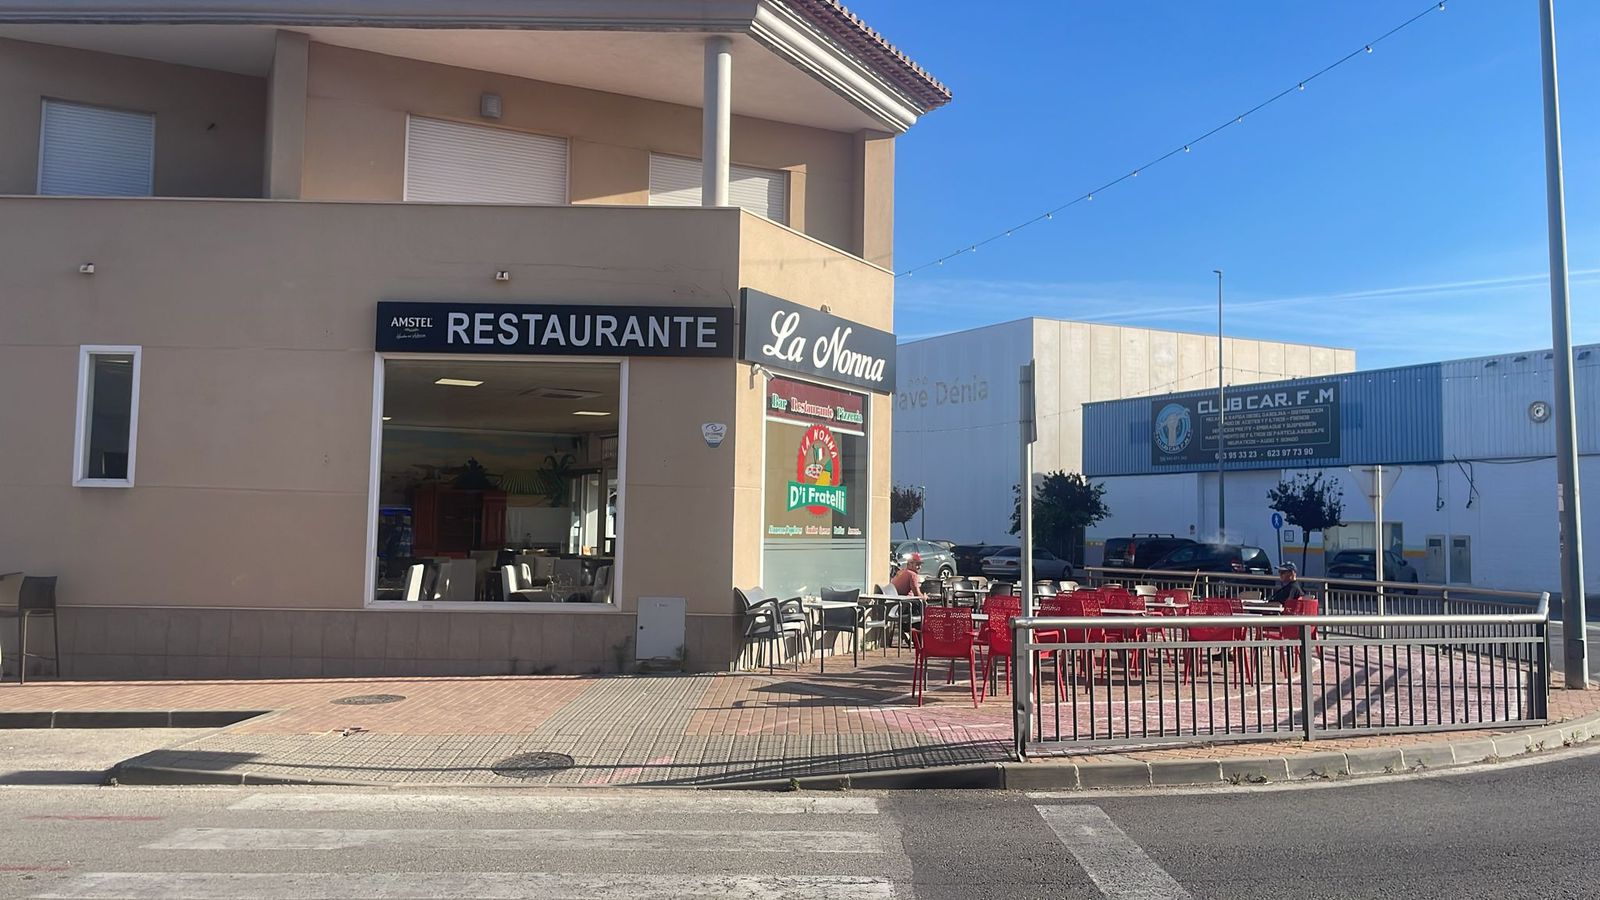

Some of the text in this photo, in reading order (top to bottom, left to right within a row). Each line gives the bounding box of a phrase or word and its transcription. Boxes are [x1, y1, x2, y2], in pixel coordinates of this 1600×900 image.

[390, 316, 433, 328] AMSTEL
[447, 312, 717, 348] RESTAURANTE
[762, 310, 886, 382] La Nonna
[771, 392, 788, 410] Bar
[936, 374, 988, 405] Dénia
[801, 429, 838, 458] LA NONNA
[1215, 451, 1227, 460] 63
[1238, 450, 1247, 458] 33
[1248, 450, 1257, 458] 23
[1267, 449, 1280, 457] 623
[1282, 448, 1291, 456] 97
[1293, 448, 1302, 456] 73
[1304, 447, 1313, 455] 90
[789, 485, 845, 512] D'i Fratelli
